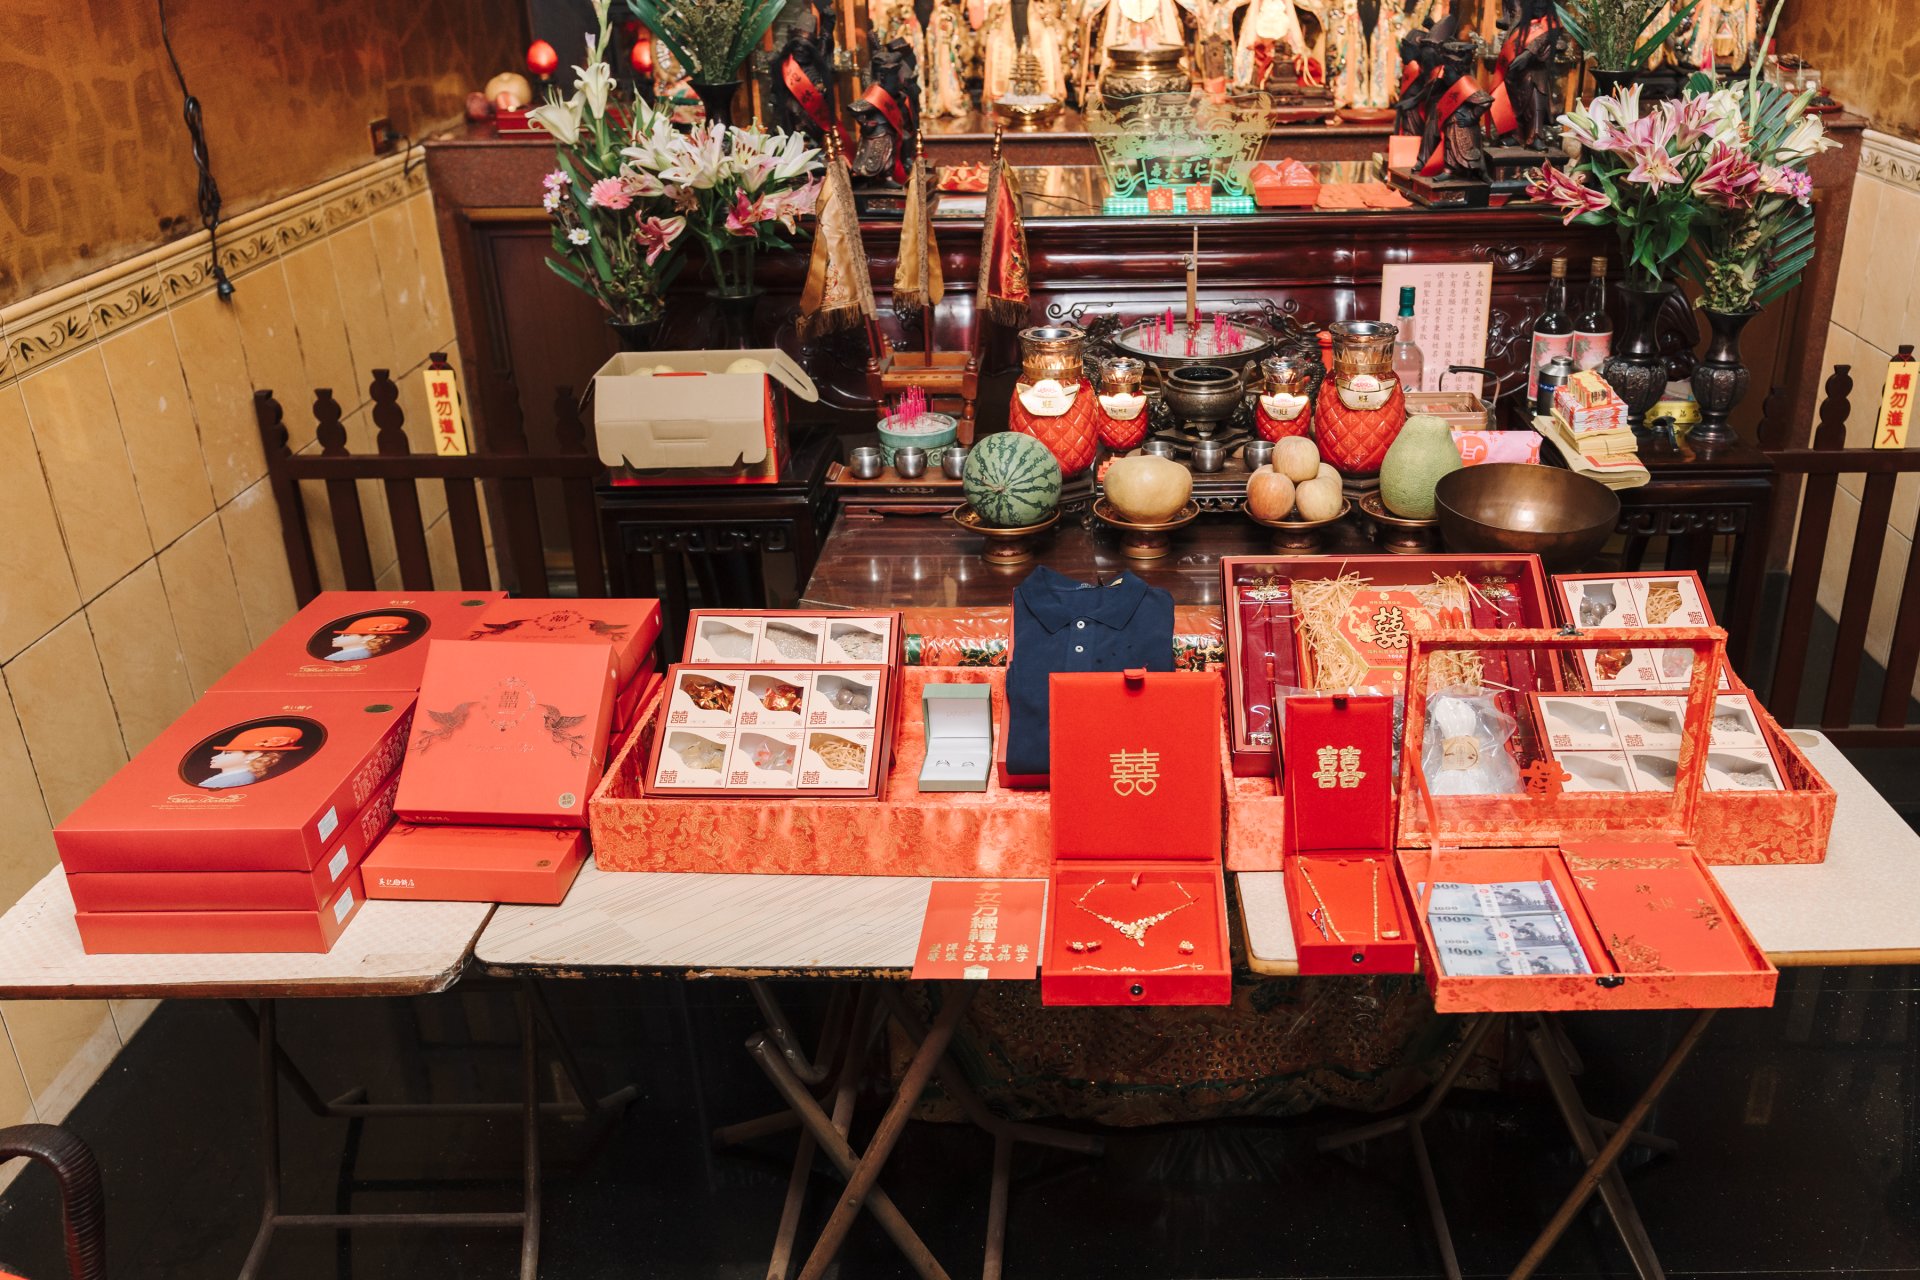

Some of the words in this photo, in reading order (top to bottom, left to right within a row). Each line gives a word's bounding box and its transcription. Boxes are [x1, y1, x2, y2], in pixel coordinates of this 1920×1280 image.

[432, 382, 459, 452] 請勿進入
[1882, 373, 1911, 445] 請勿進入
